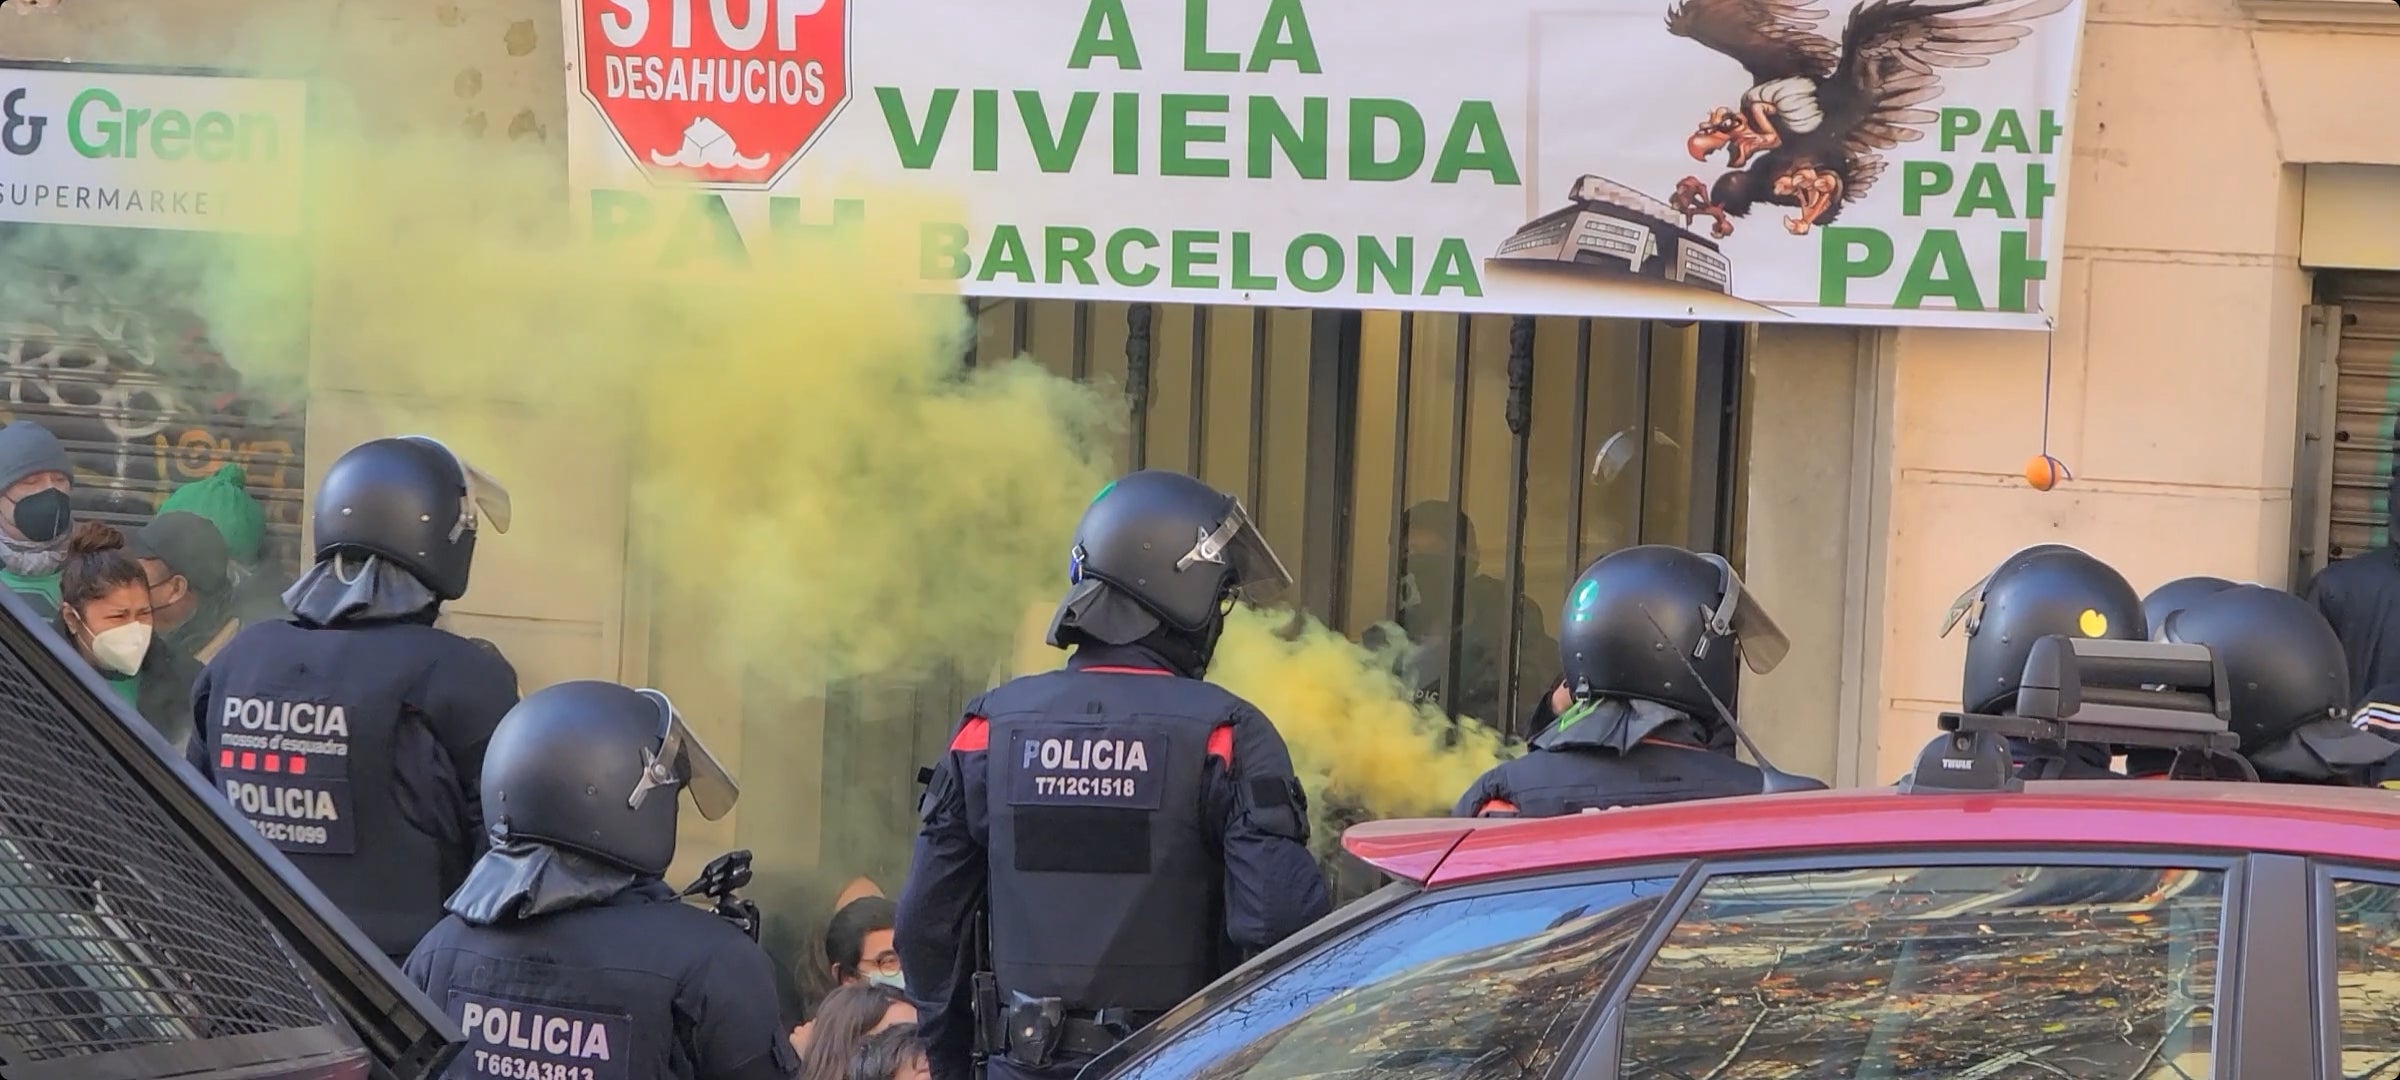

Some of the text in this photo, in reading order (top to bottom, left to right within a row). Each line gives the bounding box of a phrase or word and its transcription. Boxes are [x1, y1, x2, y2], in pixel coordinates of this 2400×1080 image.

[601, 0, 827, 51] STOP
[1067, 0, 1323, 74] A LA
[606, 55, 825, 105] DESAHUCIOS
[2, 88, 279, 163] & Green
[874, 86, 1521, 185] VIVIENDA
[919, 222, 1483, 298] BARCELONA
[221, 733, 268, 749] mossos
[222, 697, 348, 737] POLICIA
[1023, 738, 1148, 771] POLICIA
[226, 779, 338, 821] POLICIA
[1035, 776, 1135, 797] T712C1518
[462, 1002, 610, 1061] POLICIA
